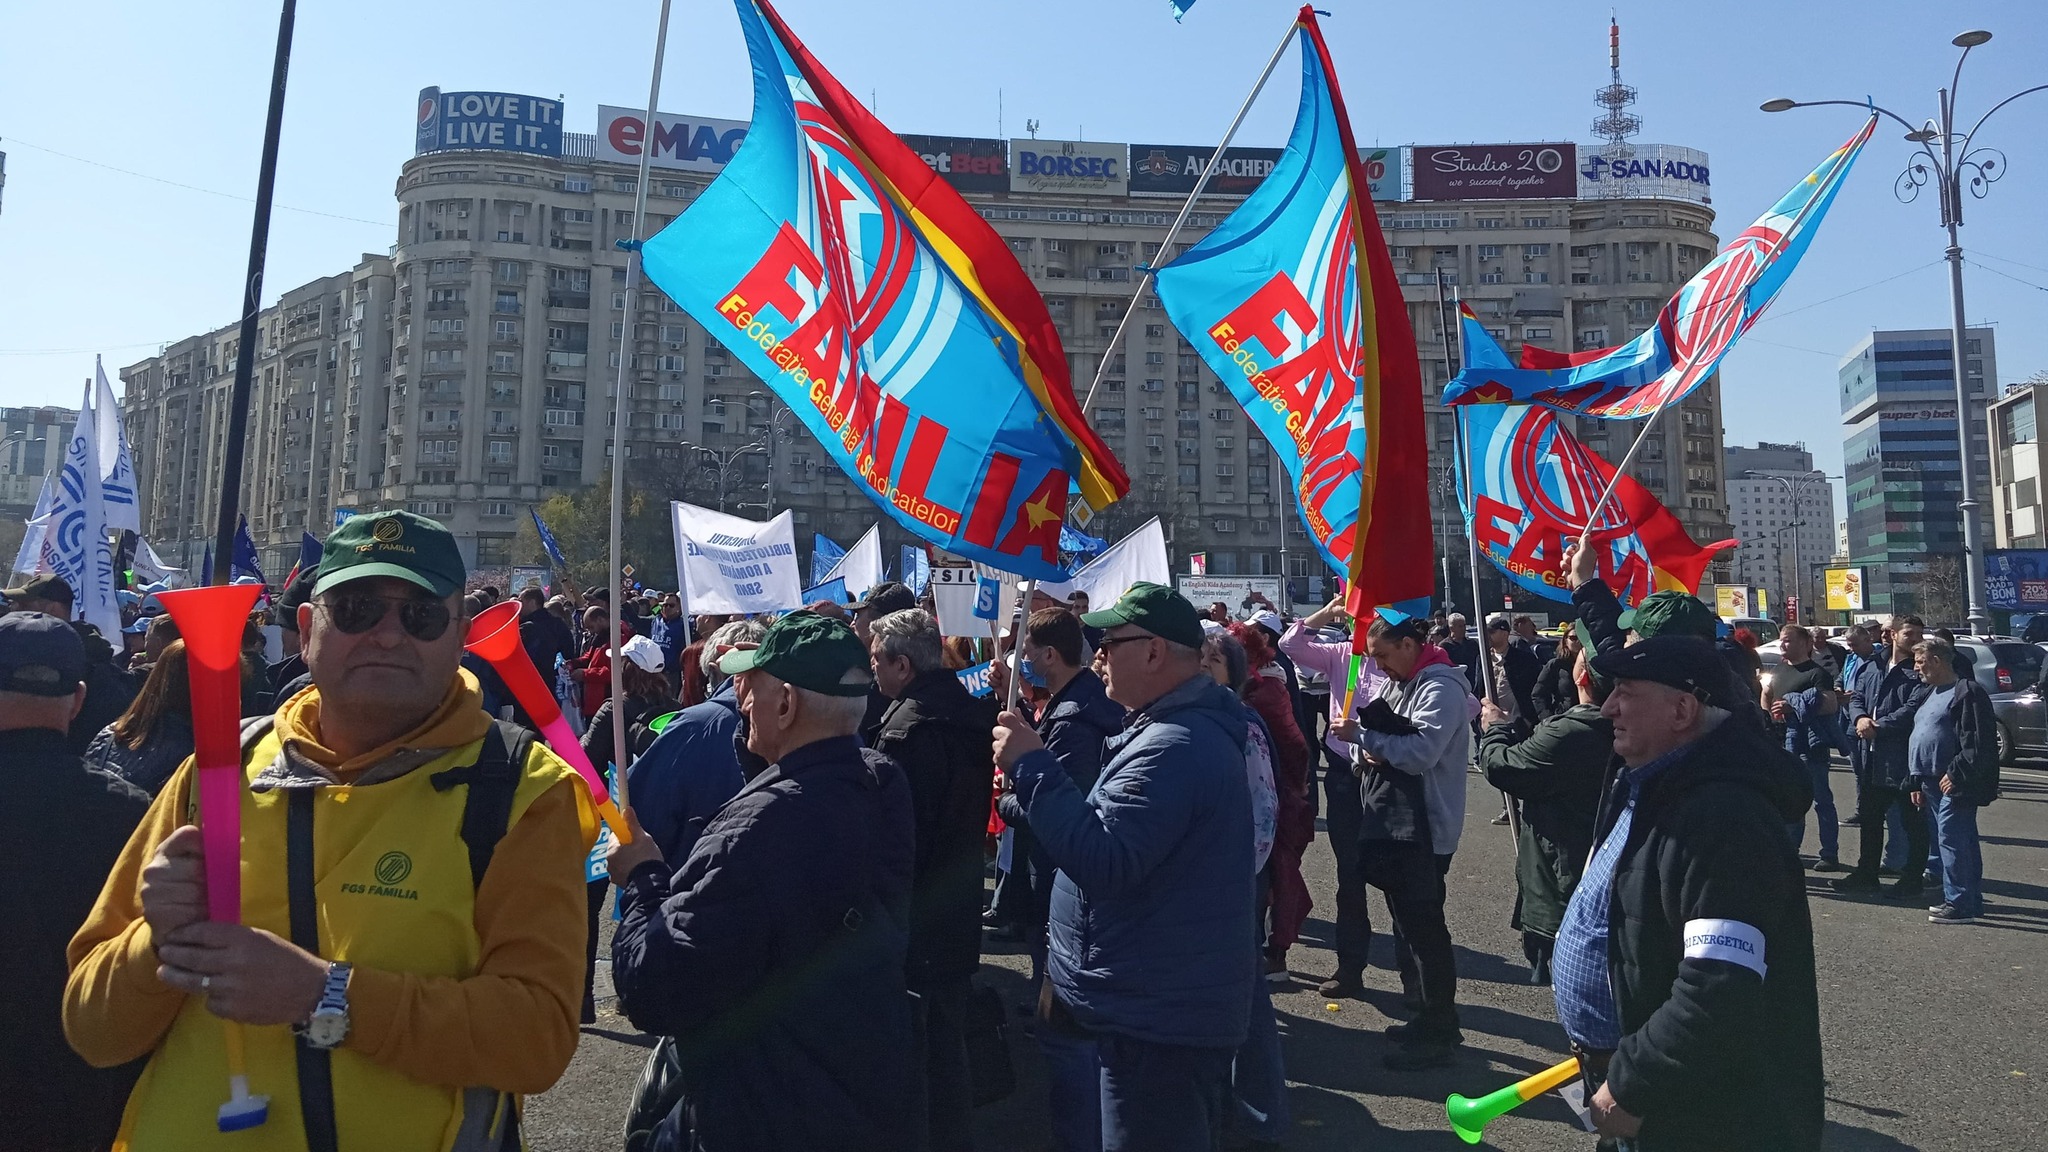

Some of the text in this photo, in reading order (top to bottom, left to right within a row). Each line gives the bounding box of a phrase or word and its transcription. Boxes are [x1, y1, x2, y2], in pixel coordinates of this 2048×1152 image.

[447, 95, 561, 126] LOVE IT.
[418, 130, 436, 140] pepsi
[446, 122, 548, 149] LIVE IT.
[913, 151, 1003, 177] etBet
[1019, 151, 1118, 179] BORSEC
[1431, 148, 1562, 173] Studio 20
[1611, 158, 1711, 186] SANADOR
[1449, 175, 1545, 190] we succeed together
[858, 453, 958, 535] Sindicatelor
[355, 543, 416, 554] FGS FAMILIA
[1188, 581, 1207, 589] English
[1219, 581, 1244, 589] Academy
[1991, 586, 2016, 600] BON!
[340, 882, 419, 900] FGS FAMILIA
[1692, 934, 1755, 955] ENERGETICA
